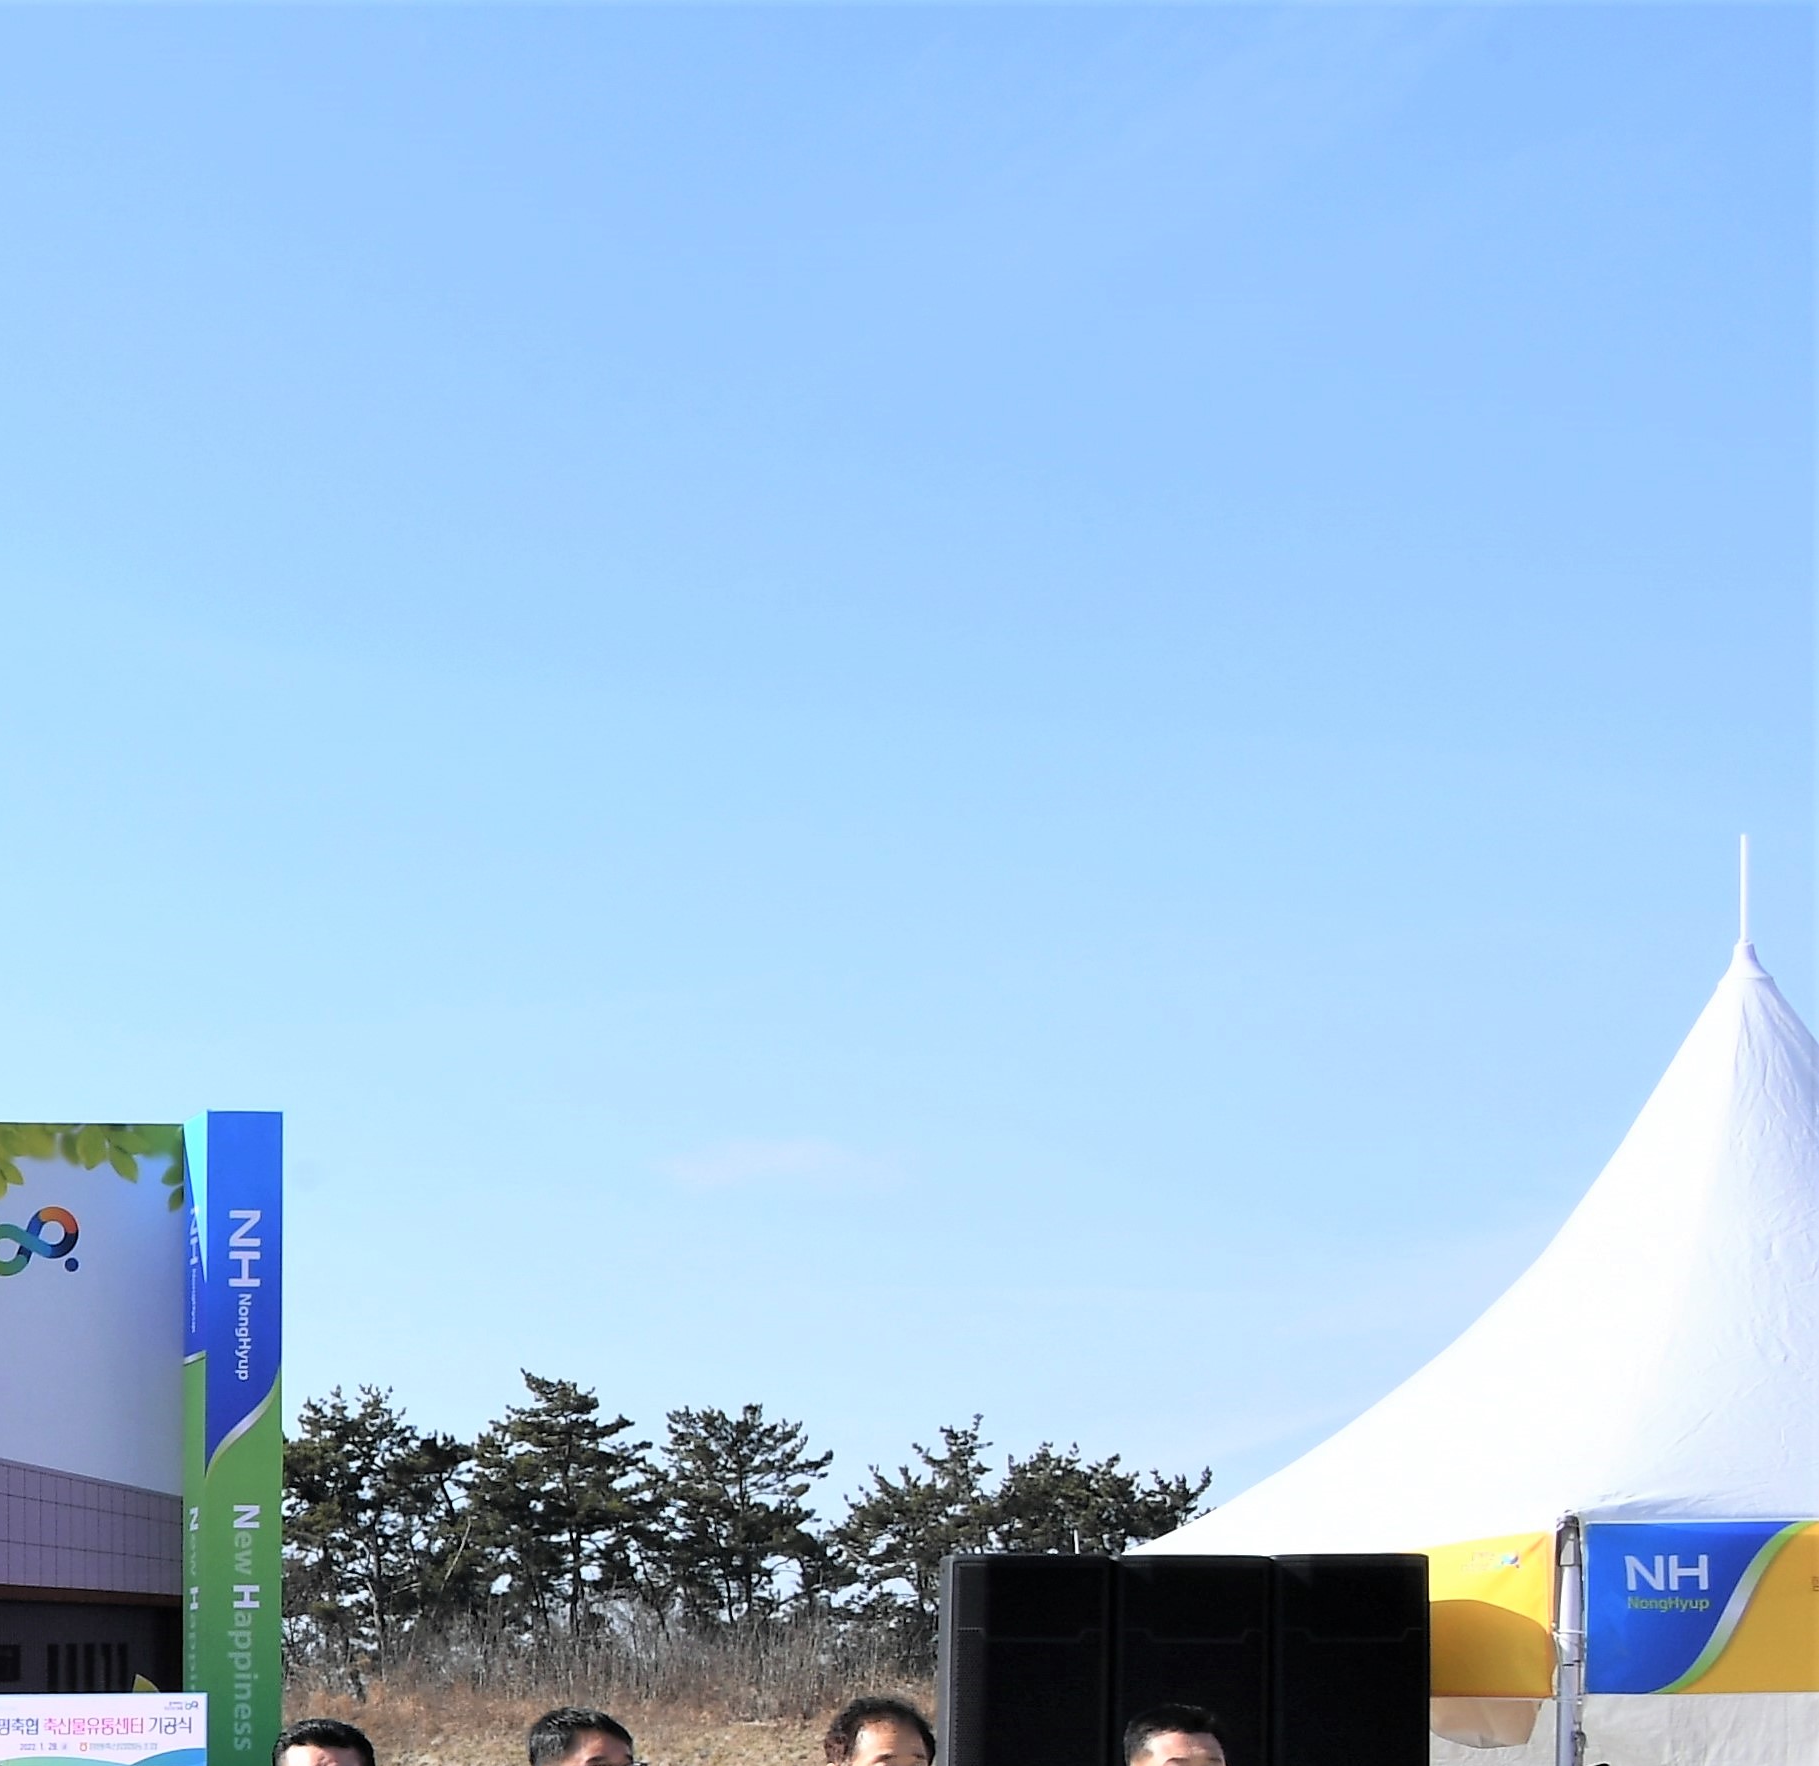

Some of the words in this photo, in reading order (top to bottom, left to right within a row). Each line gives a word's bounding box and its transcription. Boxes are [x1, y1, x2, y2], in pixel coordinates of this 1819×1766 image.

[228, 1210, 261, 1288] NH
[235, 1293, 252, 1381] NongHyup
[233, 1504, 260, 1575] New
[1624, 1554, 1708, 1591] NH
[1628, 1596, 1709, 1612] NongHyup
[228, 1584, 260, 1750] Happiness
[148, 1716, 193, 1735] 기공식
